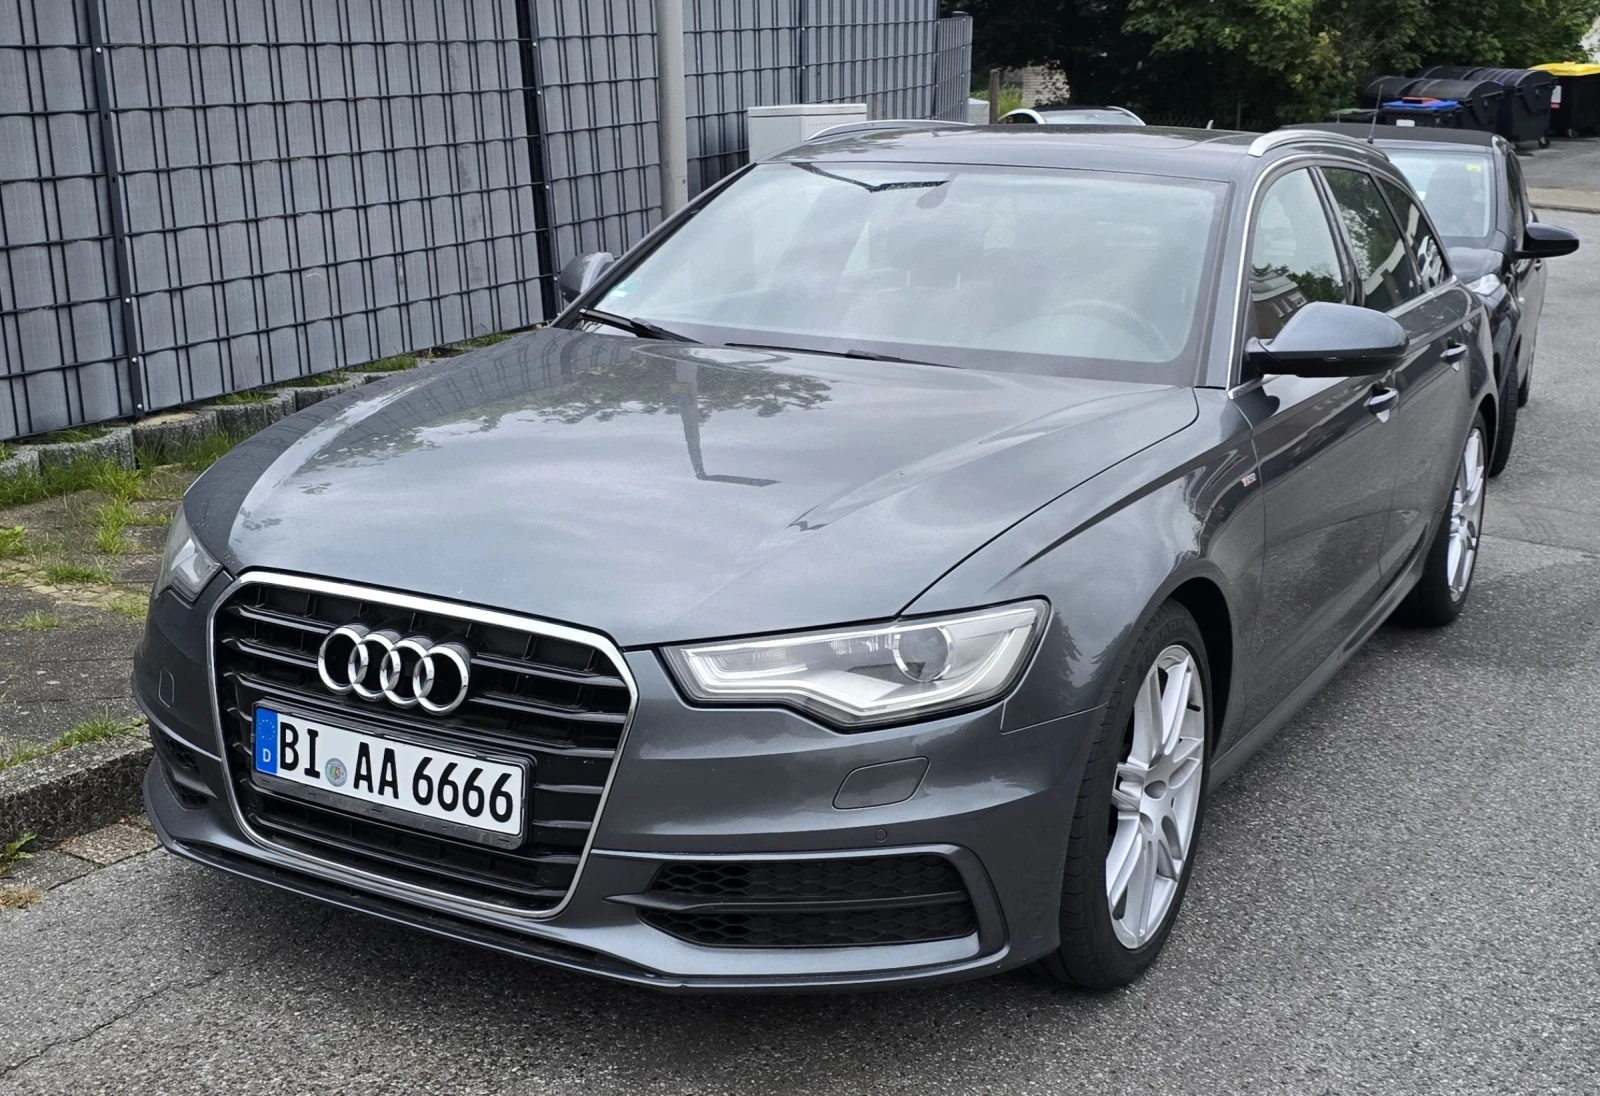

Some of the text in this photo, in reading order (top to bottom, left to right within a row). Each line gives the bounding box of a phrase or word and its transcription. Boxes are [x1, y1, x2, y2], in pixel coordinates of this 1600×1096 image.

[262, 748, 271, 763] D
[280, 722, 513, 823] BI AA 6666
